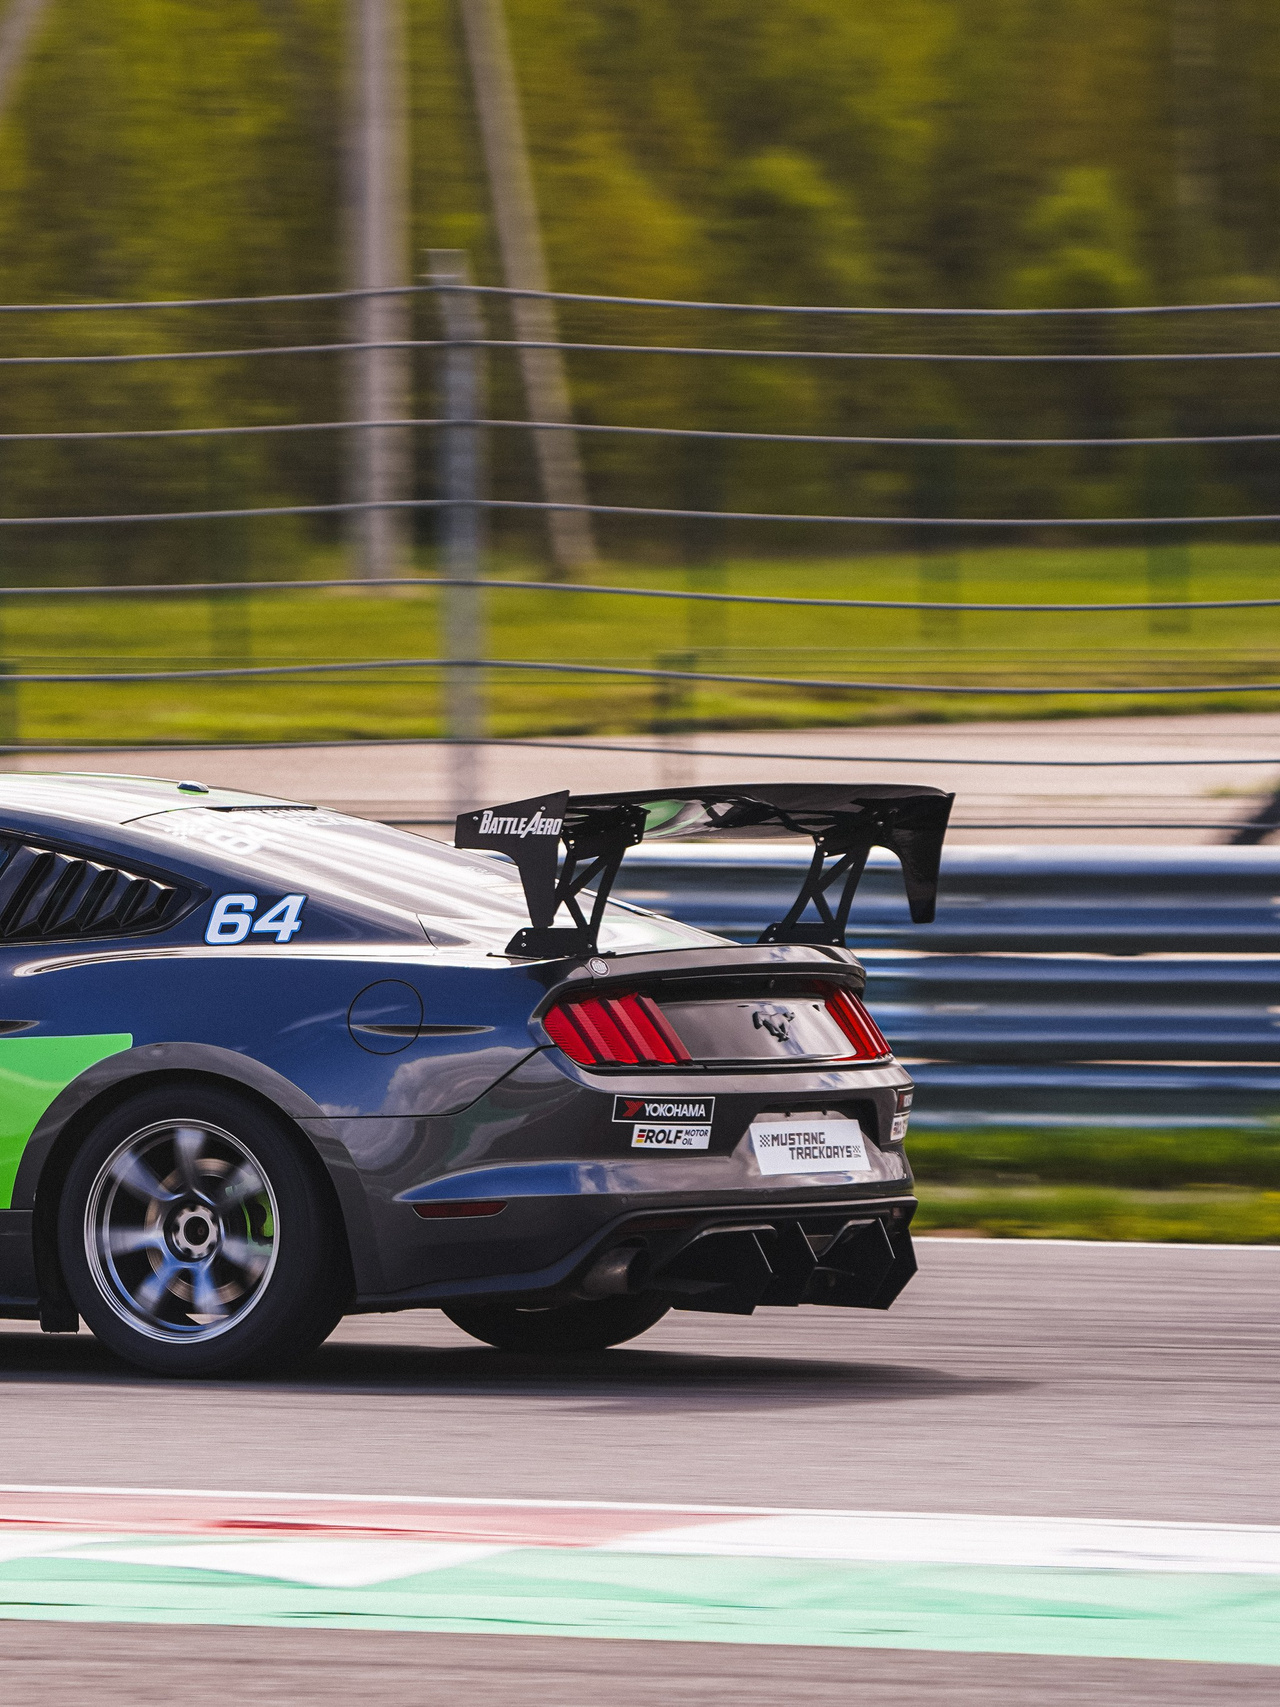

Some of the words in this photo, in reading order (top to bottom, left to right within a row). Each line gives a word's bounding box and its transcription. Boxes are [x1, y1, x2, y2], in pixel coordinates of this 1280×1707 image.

[204, 893, 307, 945] 64
[644, 1103, 706, 1117] YOKOHAMA
[644, 1128, 684, 1144] ROLF
[684, 1129, 709, 1137] MOTOR
[681, 1137, 694, 1146] OIL
[771, 1132, 826, 1147] MUSTANG
[788, 1145, 853, 1160] TRACKDAYS
